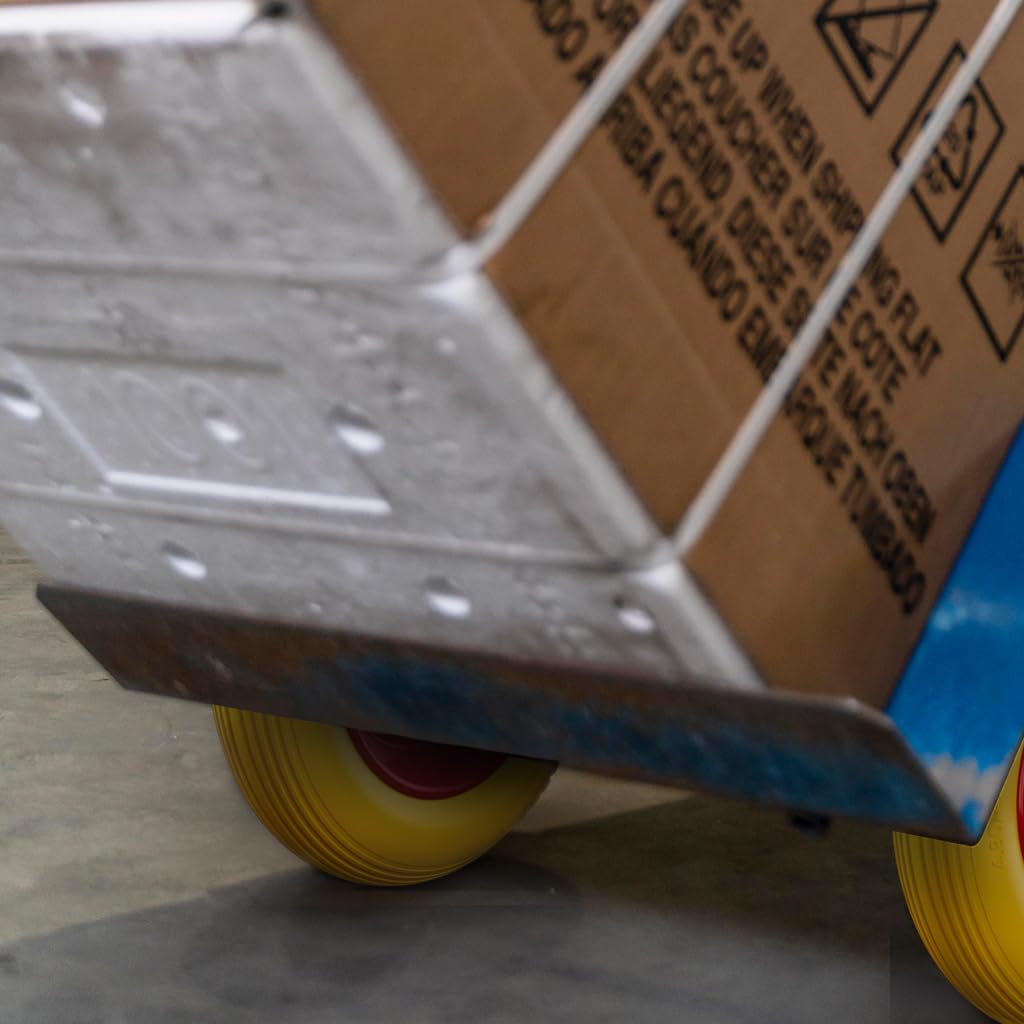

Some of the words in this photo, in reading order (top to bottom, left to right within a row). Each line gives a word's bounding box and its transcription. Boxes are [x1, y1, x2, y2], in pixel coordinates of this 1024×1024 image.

[573, 54, 665, 193] ARIBA
[653, 176, 762, 323] CUANDO
[842, 466, 927, 619] TUMBADO
[688, 43, 805, 216] COUCHER
[781, 197, 832, 279] SUR
[850, 310, 907, 405] COTE
[725, 196, 795, 305] DIESE
[835, 371, 894, 467] NACH
[883, 451, 938, 547] OBEN
[728, 19, 775, 73] UP
[757, 67, 823, 176] WHEN
[890, 291, 943, 377] FLAT
